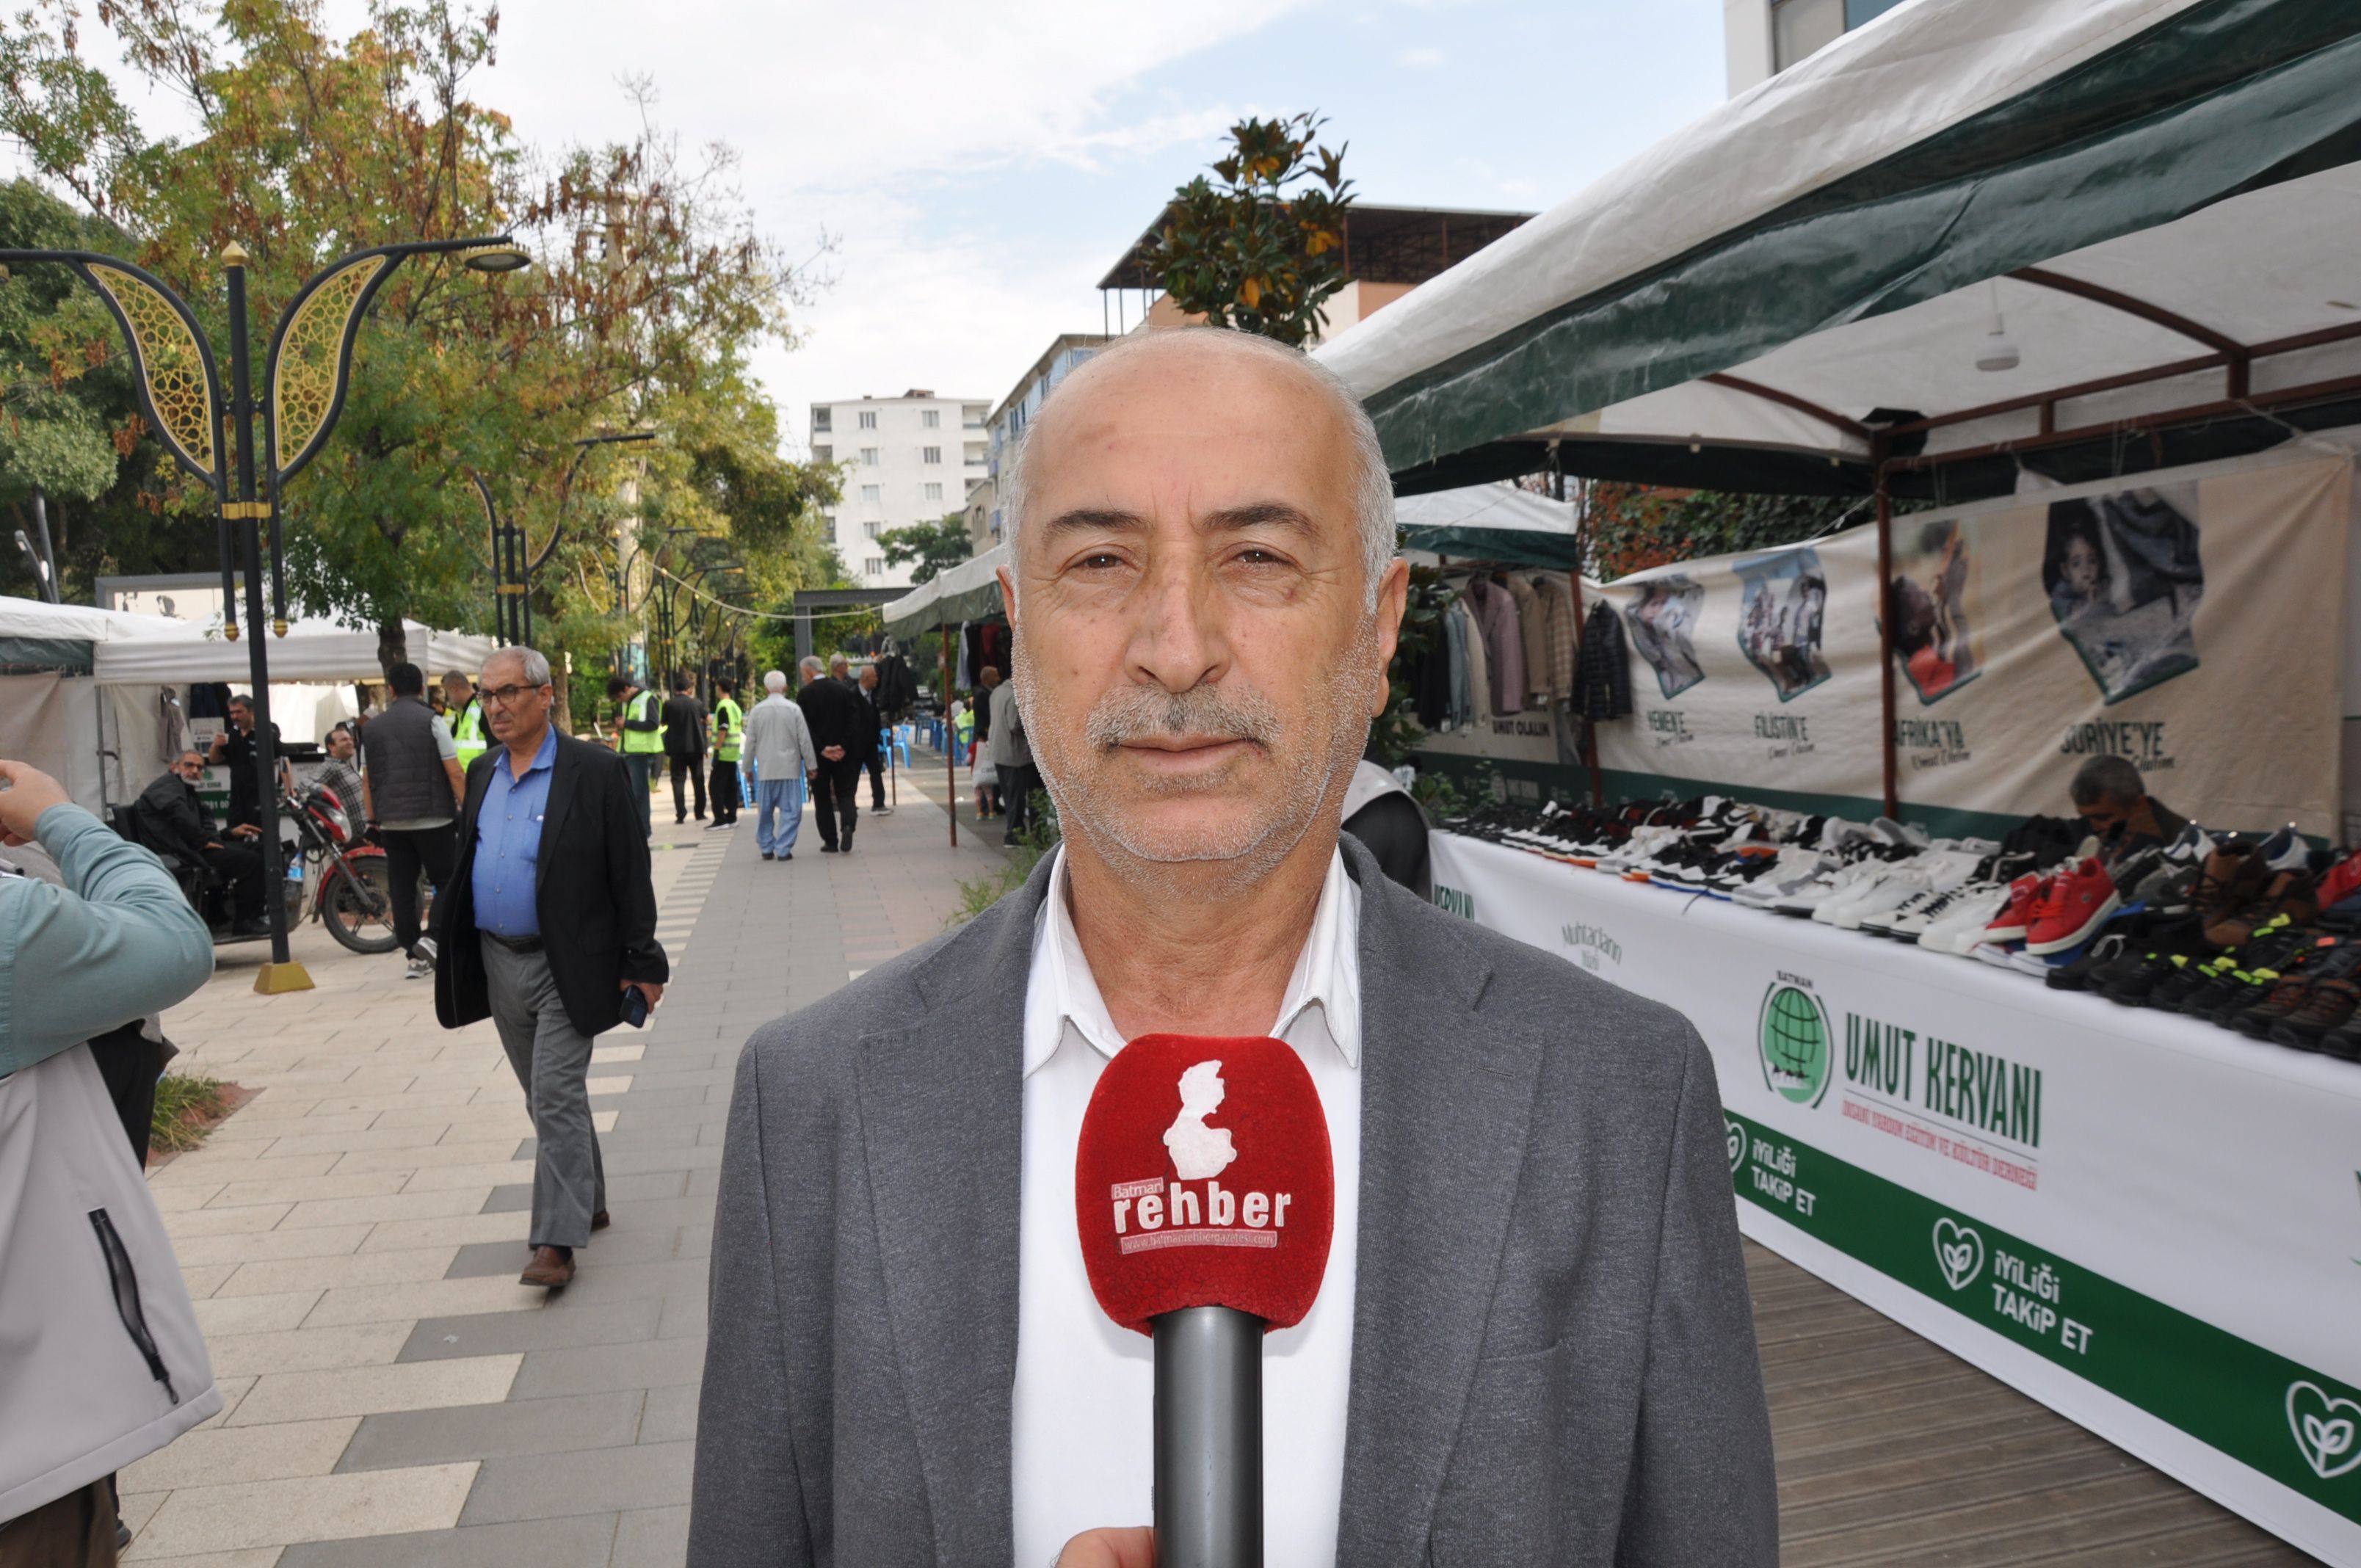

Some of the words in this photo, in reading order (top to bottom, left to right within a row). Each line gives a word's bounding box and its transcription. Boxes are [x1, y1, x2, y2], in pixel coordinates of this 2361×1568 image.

[1846, 1012, 1916, 1102] UMUT
[1925, 1037, 2042, 1149] KERVANI
[1113, 1180, 1291, 1234] rehber
[1114, 1181, 1163, 1199] Batman
[1796, 1188, 1817, 1216] ET
[2061, 1317, 2094, 1354] ET
